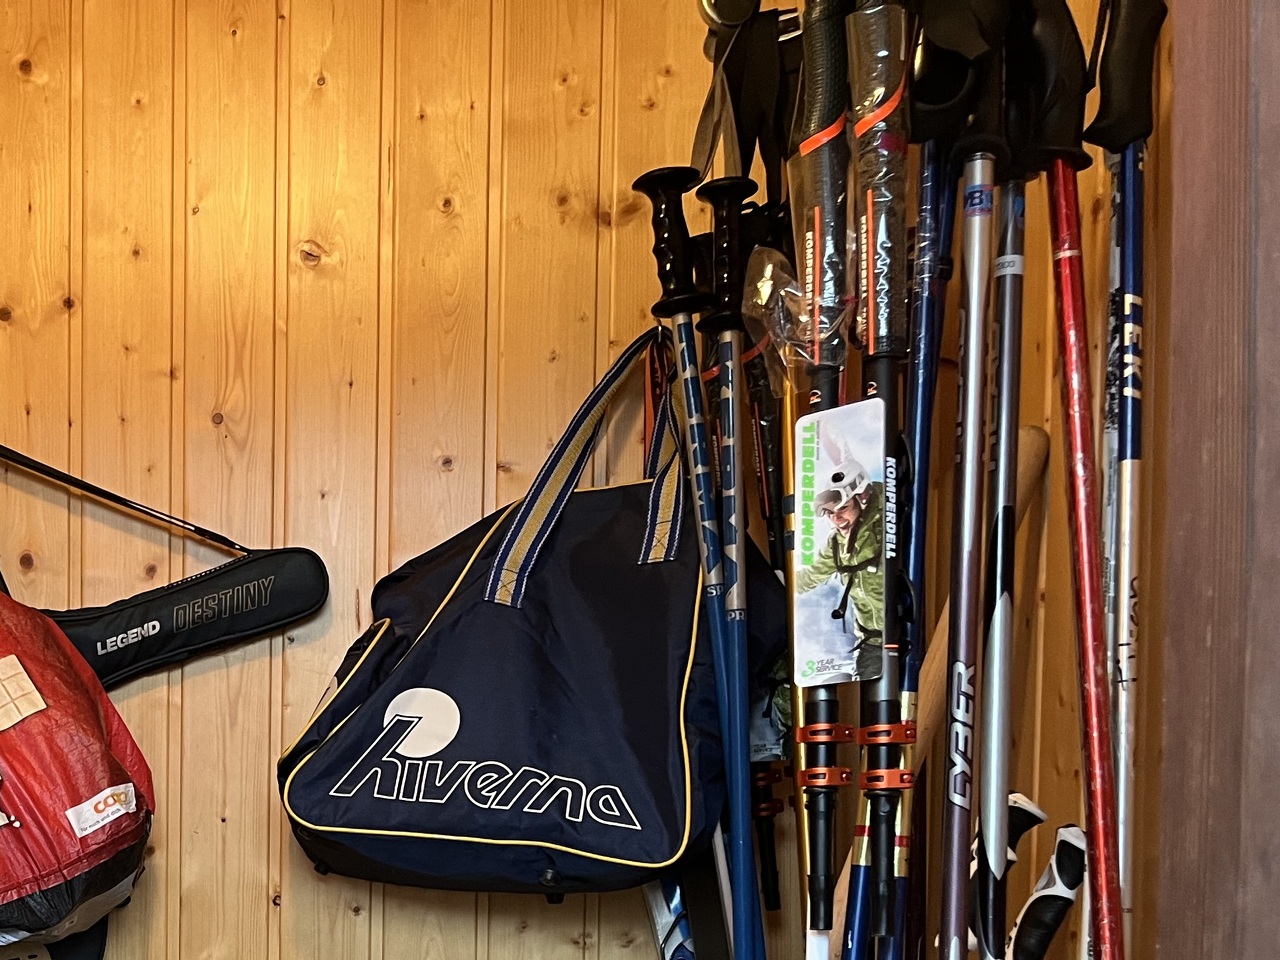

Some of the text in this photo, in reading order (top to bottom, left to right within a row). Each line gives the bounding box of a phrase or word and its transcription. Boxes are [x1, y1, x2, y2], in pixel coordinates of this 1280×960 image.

[1122, 293, 1144, 399] LEKI
[801, 421, 816, 566] KOMPERDELL
[885, 456, 897, 560] KOMPERDELL
[95, 619, 161, 657] LEGEND
[171, 573, 277, 633] DESTINY
[948, 661, 976, 810] CYBER
